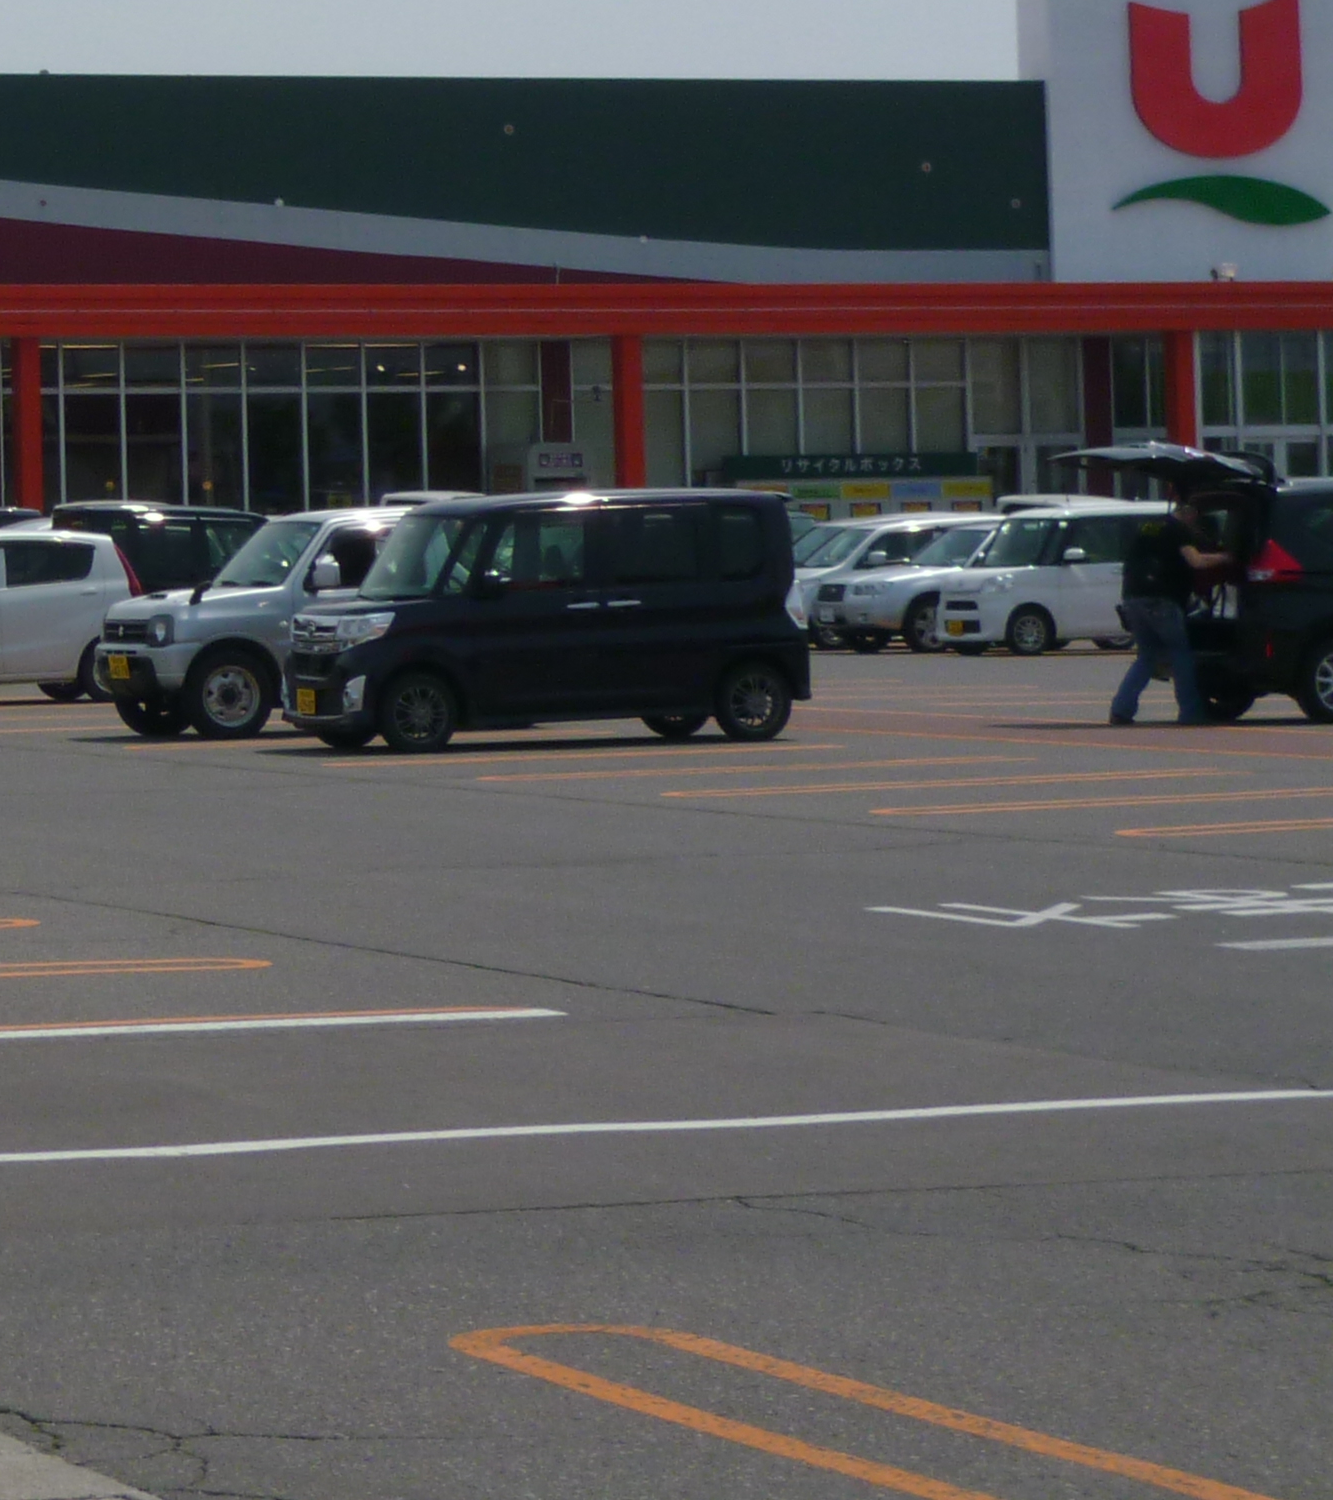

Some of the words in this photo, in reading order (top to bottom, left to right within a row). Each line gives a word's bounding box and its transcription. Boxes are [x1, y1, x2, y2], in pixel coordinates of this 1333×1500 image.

[781, 457, 922, 474] リサイクルボックス
